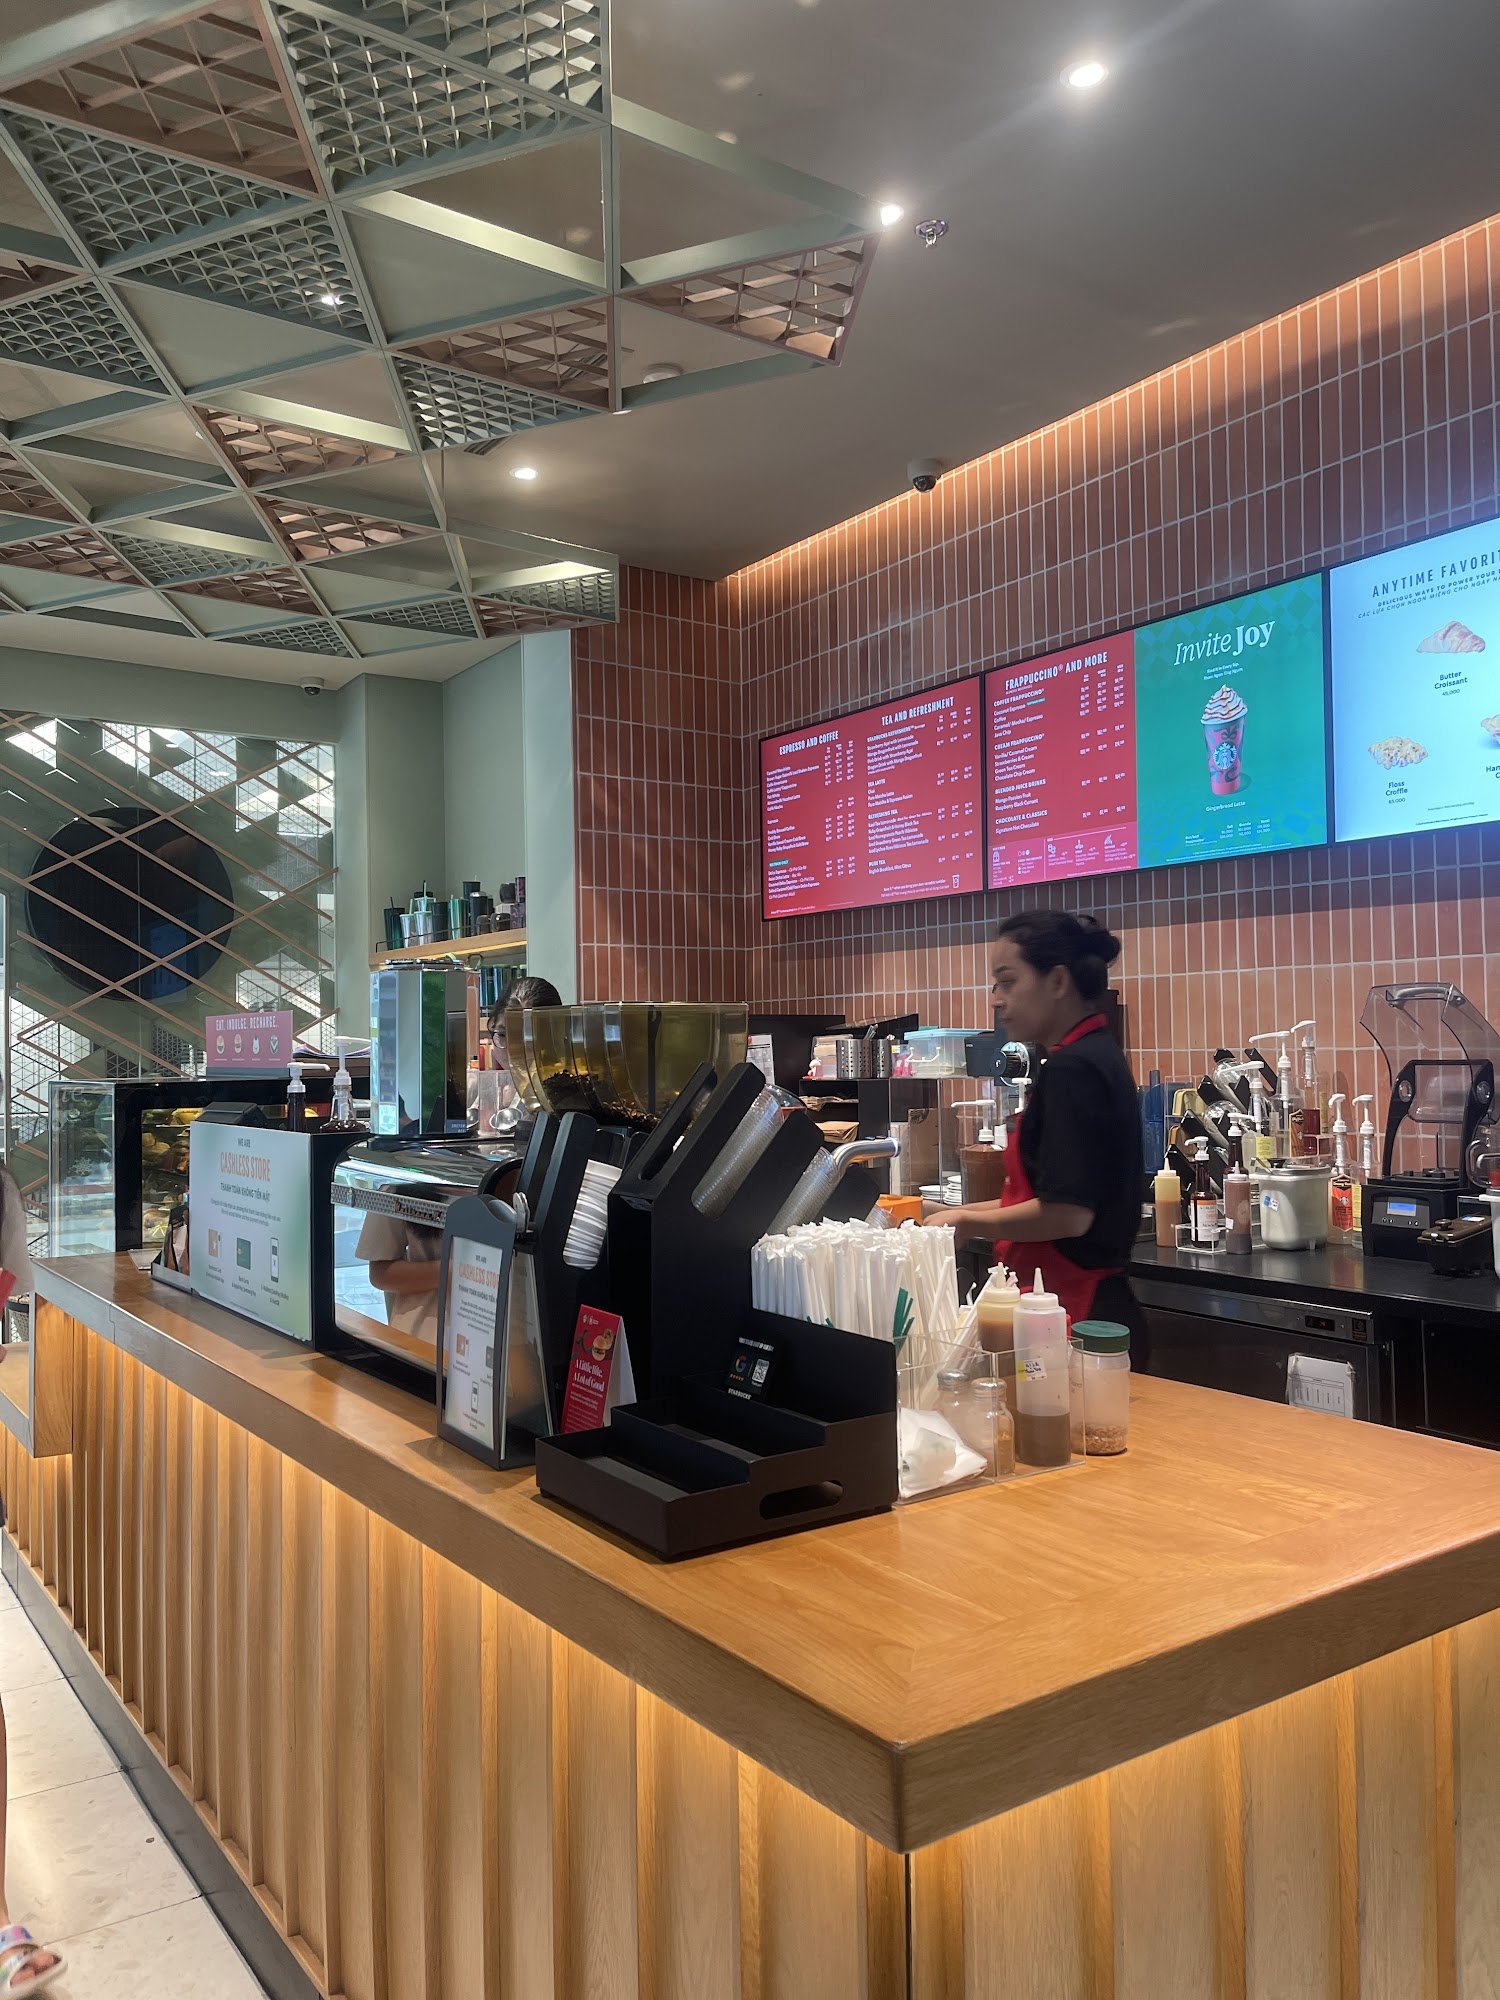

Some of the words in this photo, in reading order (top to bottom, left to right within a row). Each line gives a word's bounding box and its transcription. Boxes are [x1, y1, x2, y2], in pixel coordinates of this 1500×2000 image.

[1372, 569, 1434, 598] ANYTIME
[1378, 594, 1412, 607] DELICIOUS
[1415, 588, 1434, 597] WAYS
[1448, 576, 1473, 588] POWER
[1476, 570, 1495, 580] YOUR
[1174, 632, 1232, 666] Invite
[1232, 620, 1276, 656] Joy
[1066, 658, 1082, 673] AND
[1084, 652, 1108, 668] MORE
[1434, 677, 1467, 689] Croissant
[1440, 672, 1462, 680] Butter
[882, 715, 893, 726] TEA
[894, 711, 907, 723] AND
[909, 696, 954, 720] REFRESHMENT
[779, 739, 805, 756] ESPRESSO
[806, 736, 817, 750] AND
[819, 730, 839, 747] COFFEE
[1385, 788, 1408, 796] Croffle
[1205, 802, 1233, 812] Gingerbread
[220, 1151, 250, 1178] CASHLESS
[250, 1156, 271, 1182] STORE
[459, 1263, 485, 1285] CASHLESS
